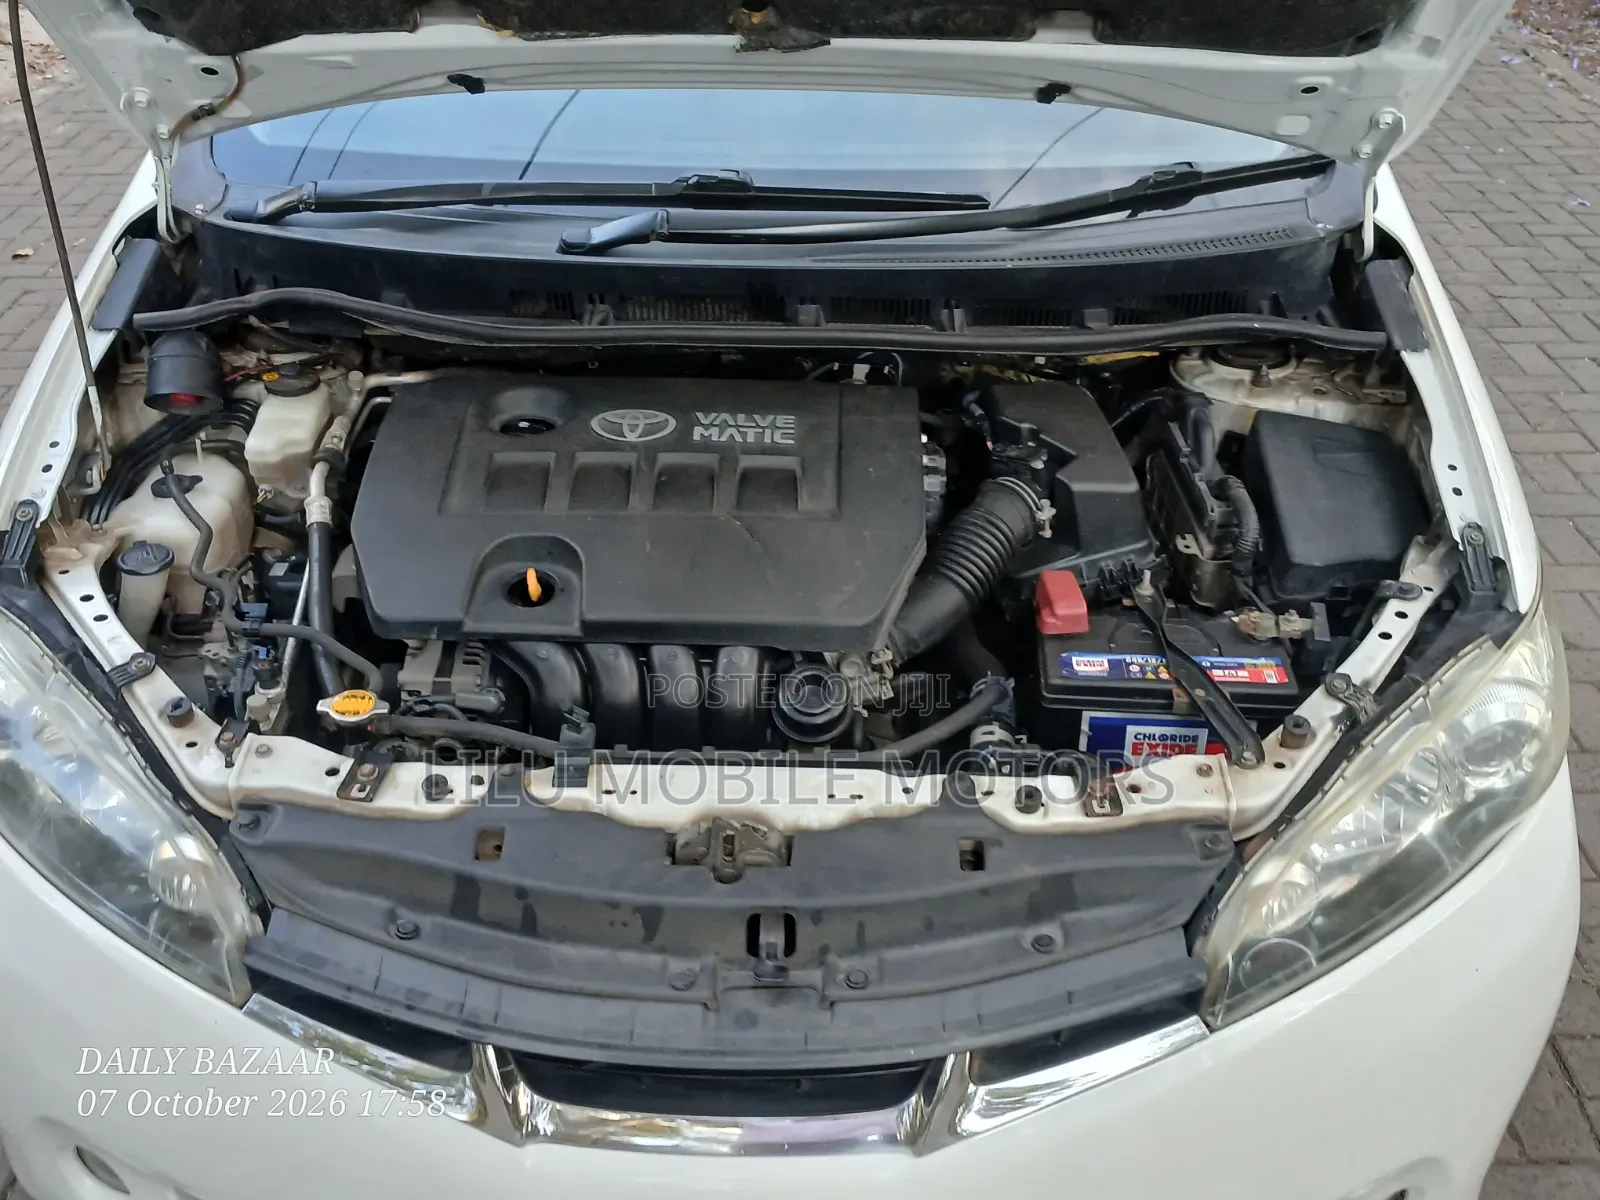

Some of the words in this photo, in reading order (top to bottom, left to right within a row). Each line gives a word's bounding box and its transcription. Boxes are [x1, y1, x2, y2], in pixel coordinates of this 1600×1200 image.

[695, 412, 796, 428] VALVE
[692, 426, 795, 444] MATIC
[1134, 732, 1199, 742] CHLORIDE
[1131, 741, 1198, 757] EXIDE
